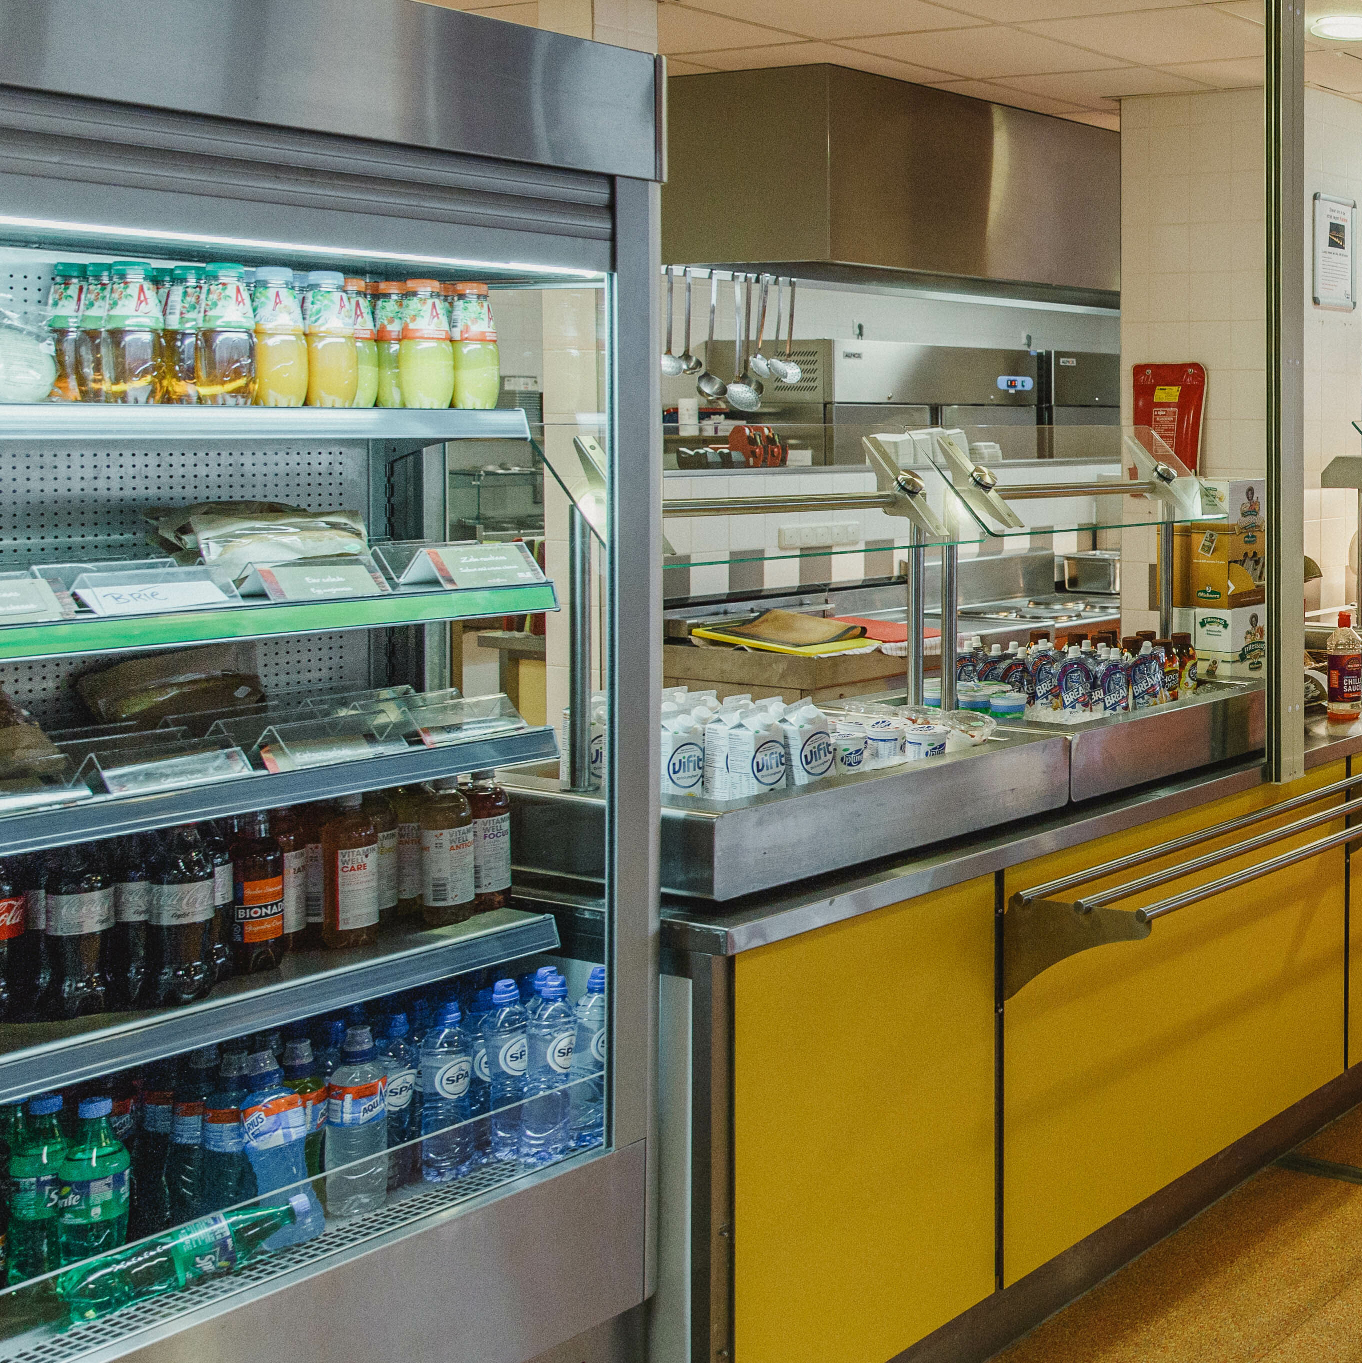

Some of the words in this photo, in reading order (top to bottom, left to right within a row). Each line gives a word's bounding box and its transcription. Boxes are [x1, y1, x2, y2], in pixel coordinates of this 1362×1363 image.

[341, 863, 368, 873] CARE
[238, 902, 284, 919] BIONAD
[509, 1049, 526, 1062] SP
[445, 1070, 469, 1085] SPA
[388, 1082, 413, 1097] SPA
